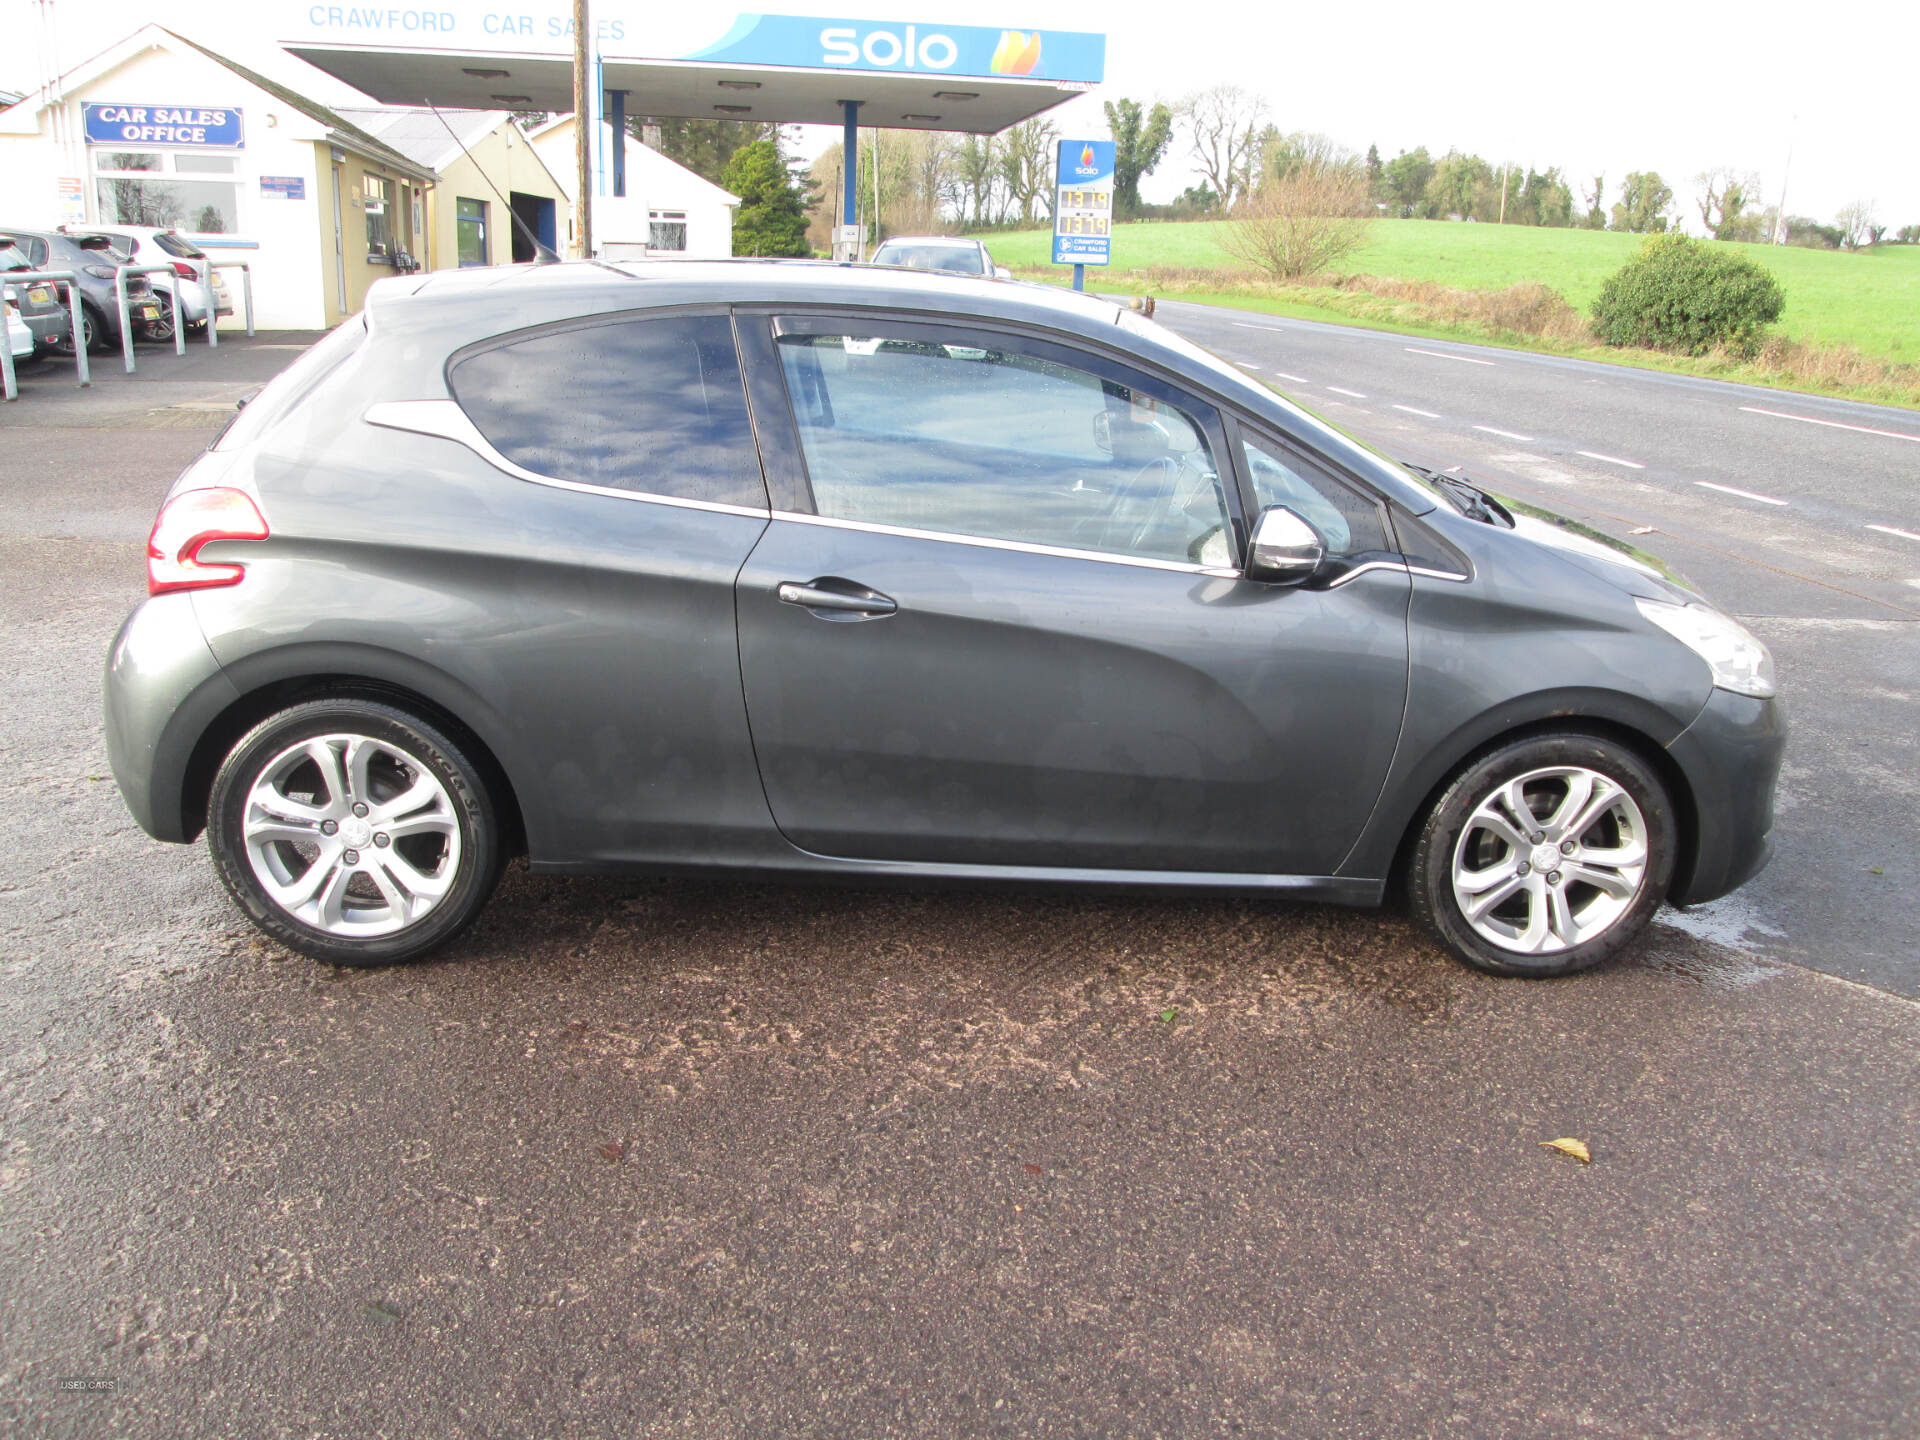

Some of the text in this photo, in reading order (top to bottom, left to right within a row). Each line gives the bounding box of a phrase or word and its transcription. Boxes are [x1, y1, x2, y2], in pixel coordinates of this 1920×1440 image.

[309, 5, 625, 40] CRAWFORD CAR SAES
[819, 25, 958, 69] solo
[99, 107, 226, 126] CAR SALES
[122, 126, 206, 142] OFFICE
[1075, 167, 1098, 175] solo
